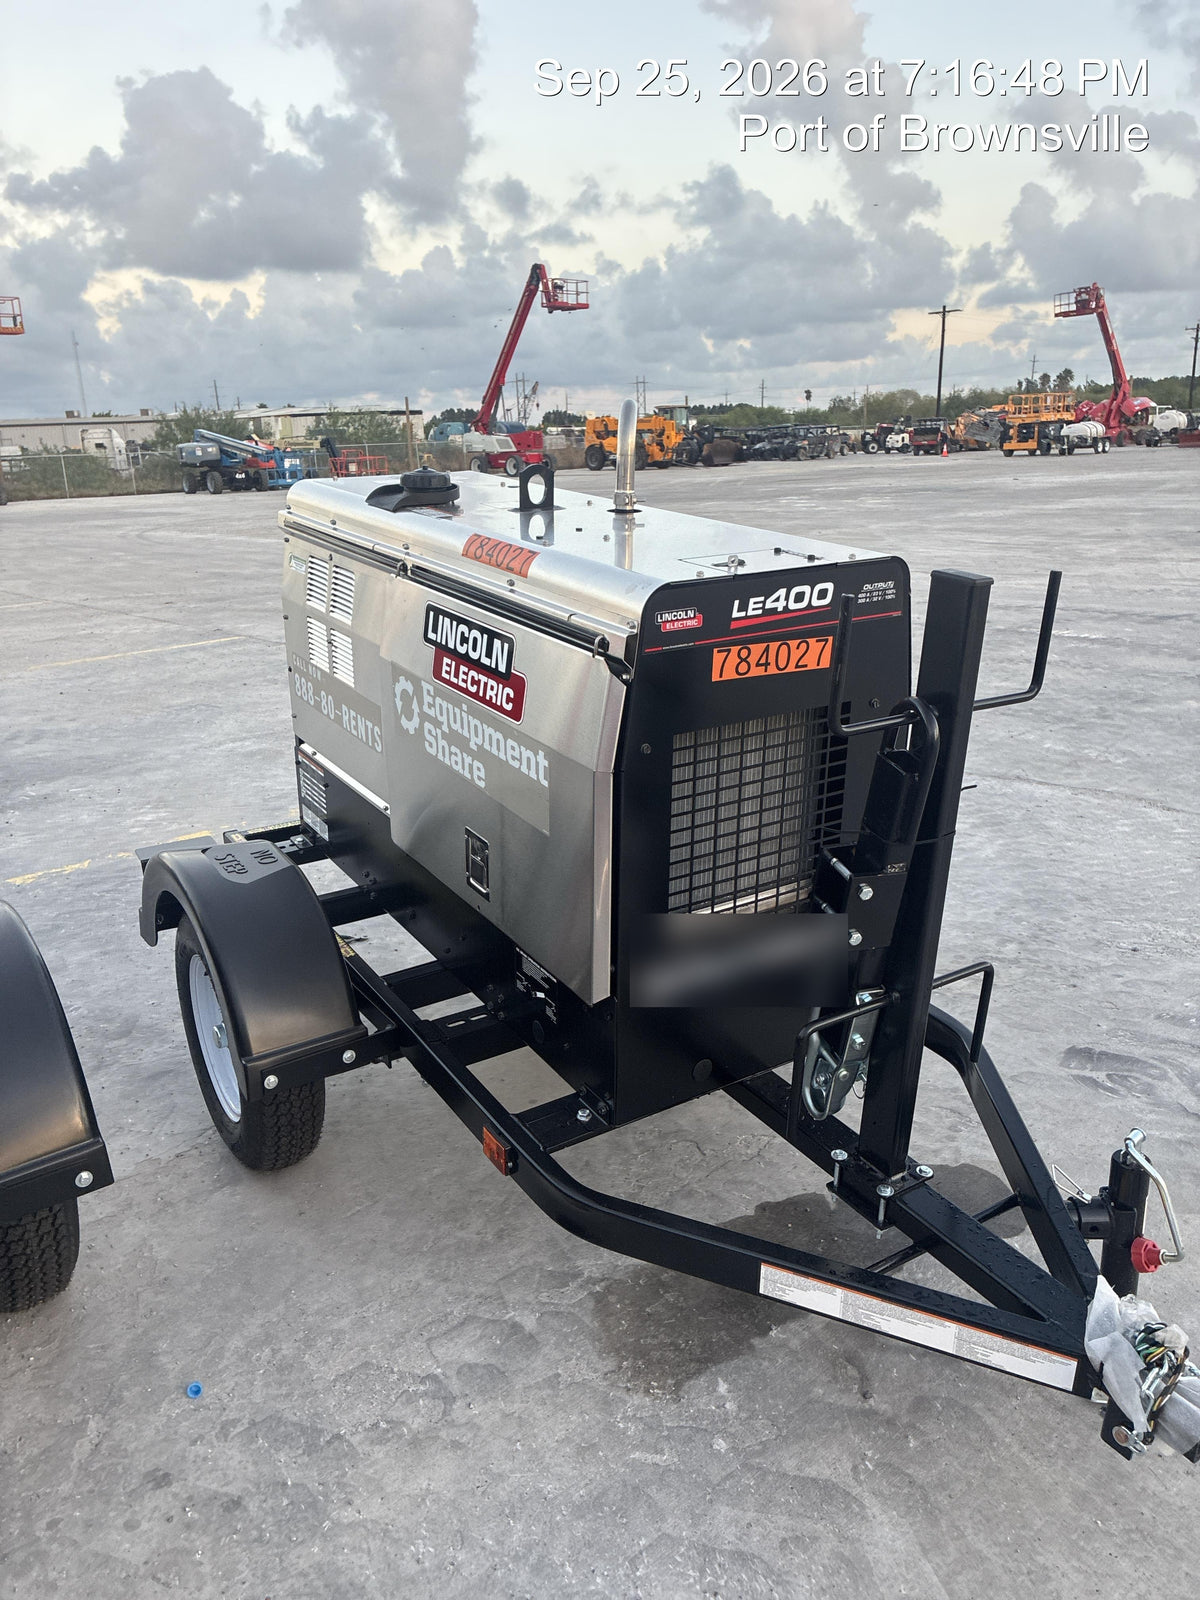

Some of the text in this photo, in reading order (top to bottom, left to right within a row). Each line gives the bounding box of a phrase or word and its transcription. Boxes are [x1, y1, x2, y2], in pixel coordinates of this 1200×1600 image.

[463, 533, 538, 575] 784027
[657, 609, 695, 623] LINCOLN
[731, 582, 835, 619] LE400
[427, 610, 509, 674] LINCOLN
[666, 619, 699, 630] ELECTRIC
[716, 637, 829, 679] 784027
[441, 656, 515, 711] ELECTRIC
[295, 673, 382, 753] 888-80-RENTS
[421, 680, 549, 788] Equipment
[423, 721, 486, 789] Share
[214, 853, 249, 875] STEP
[250, 849, 279, 865] NO
